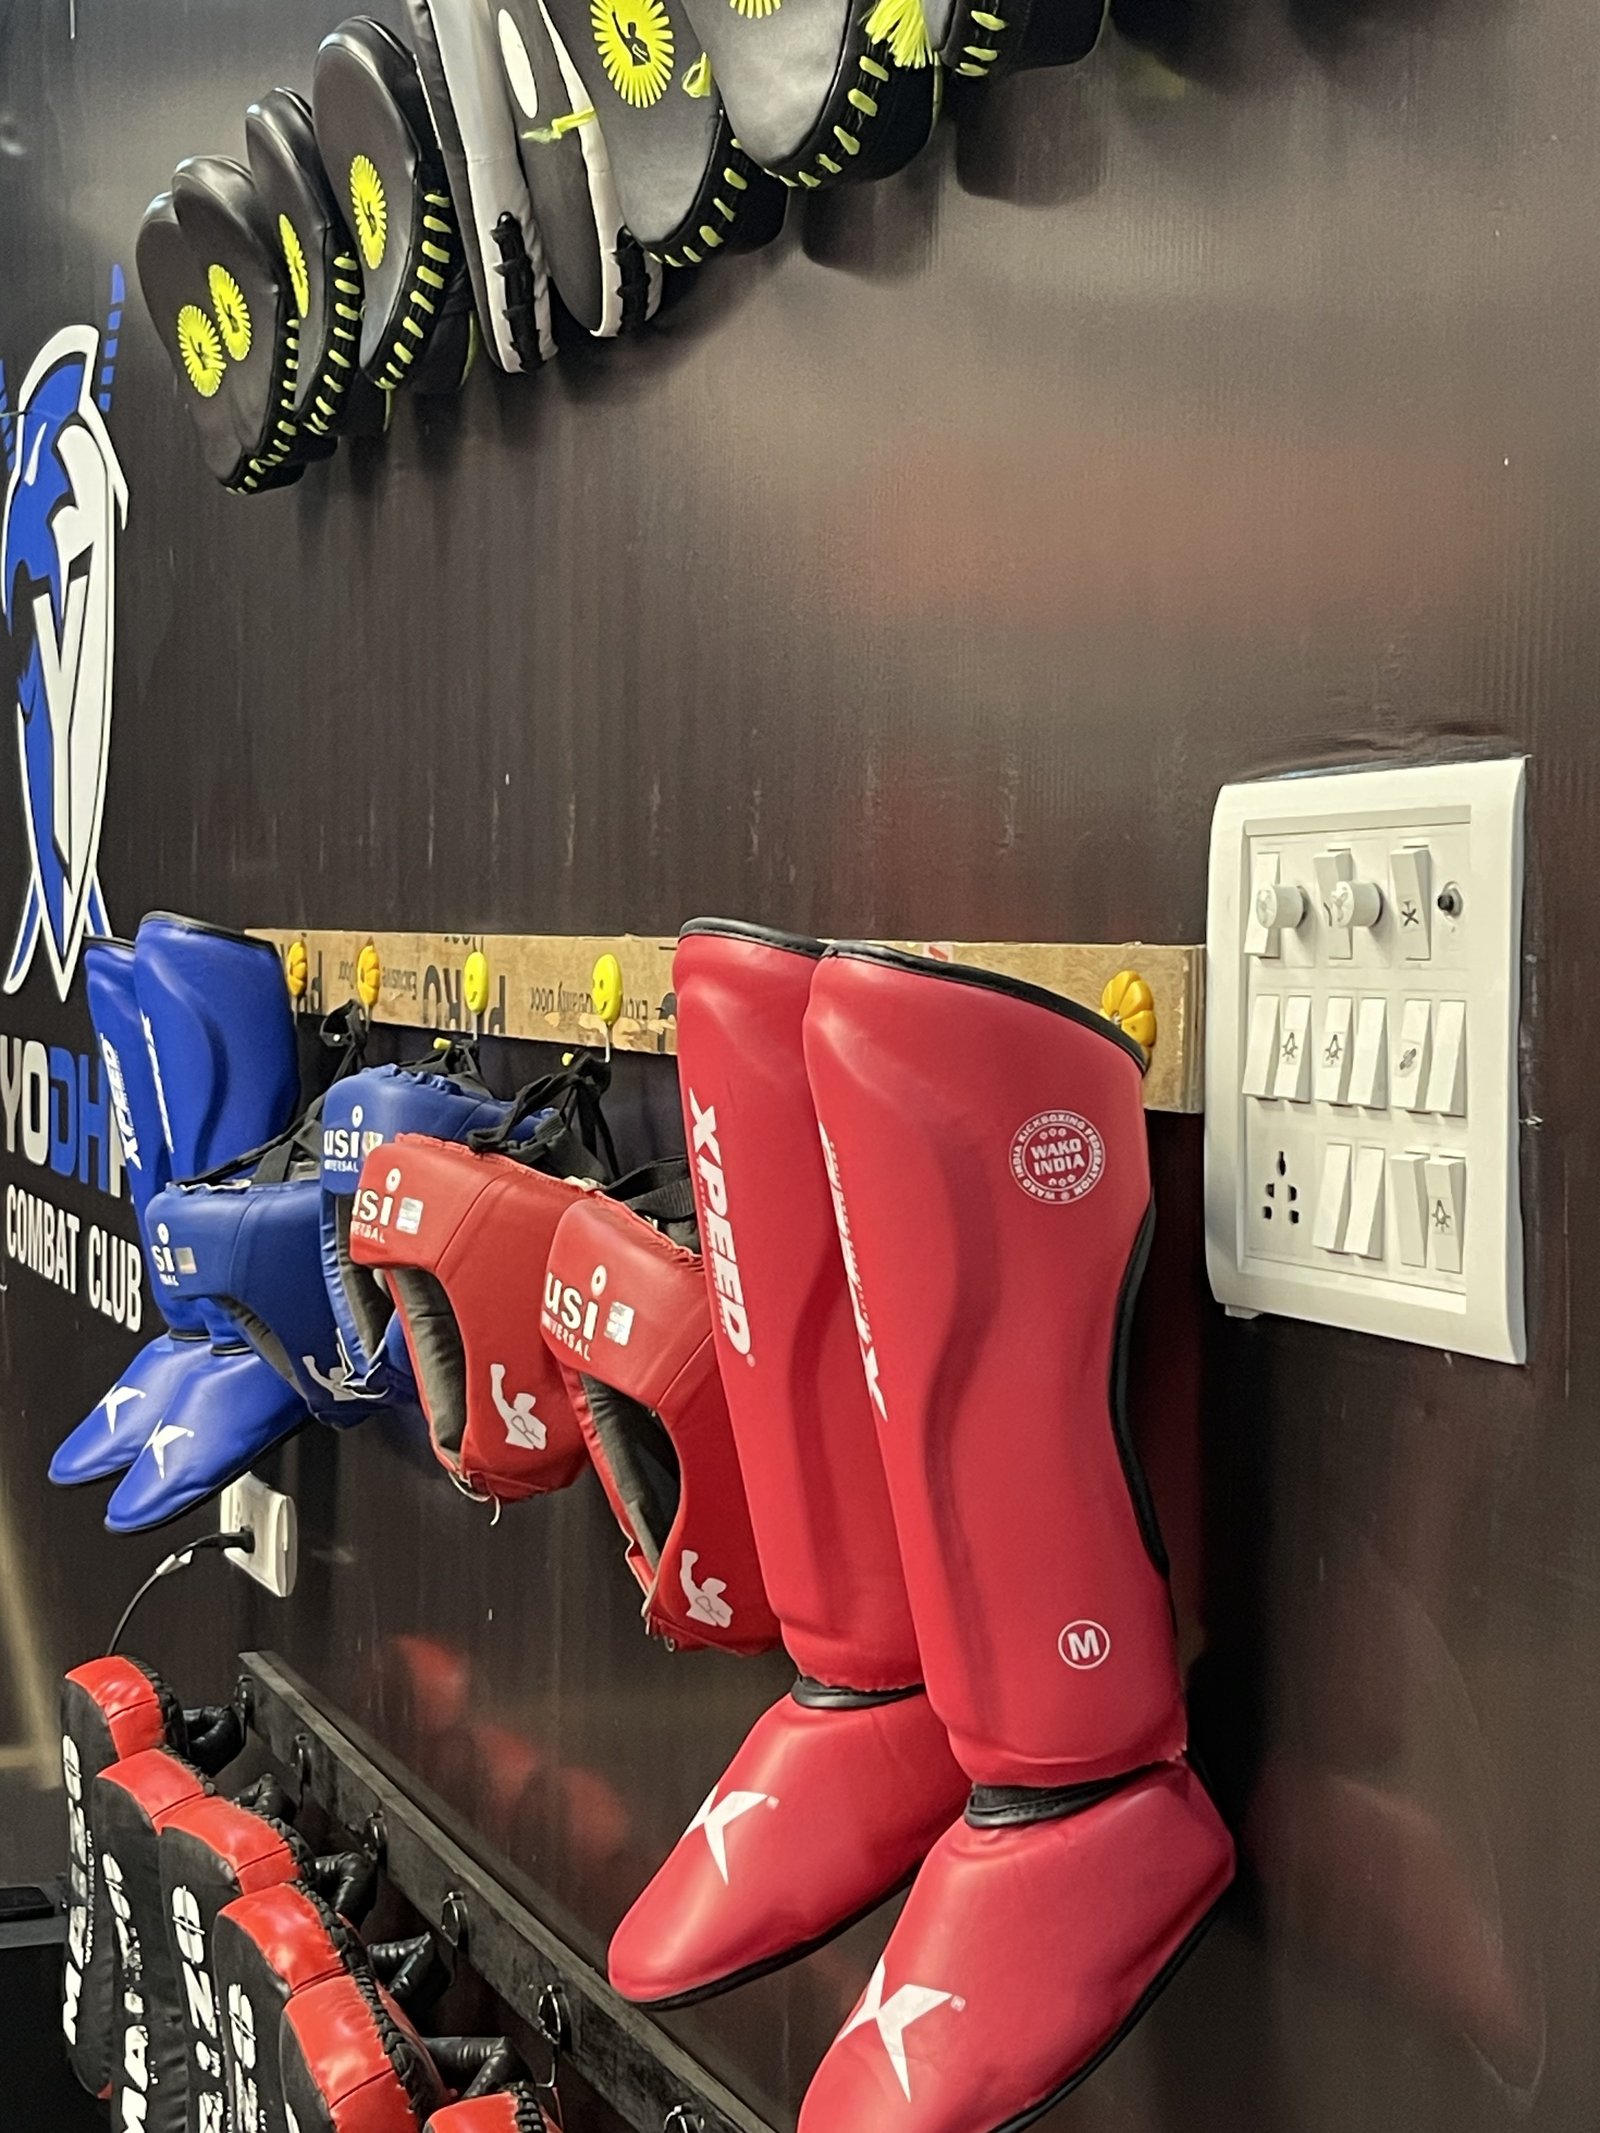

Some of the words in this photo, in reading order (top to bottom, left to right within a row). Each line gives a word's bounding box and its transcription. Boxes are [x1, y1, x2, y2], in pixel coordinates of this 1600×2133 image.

[1017, 1113, 1086, 1143] KICKBOXING
[1030, 1138, 1082, 1160] WAKO
[1033, 1153, 1085, 1176] INDIA
[1022, 1178, 1056, 1200] WAKO
[689, 1087, 751, 1356] XPEED
[6, 1184, 80, 1294] COMBAT
[88, 1224, 142, 1334] CLUB
[1067, 1628, 1100, 1661] M
[63, 1735, 88, 2045] MAIZO
